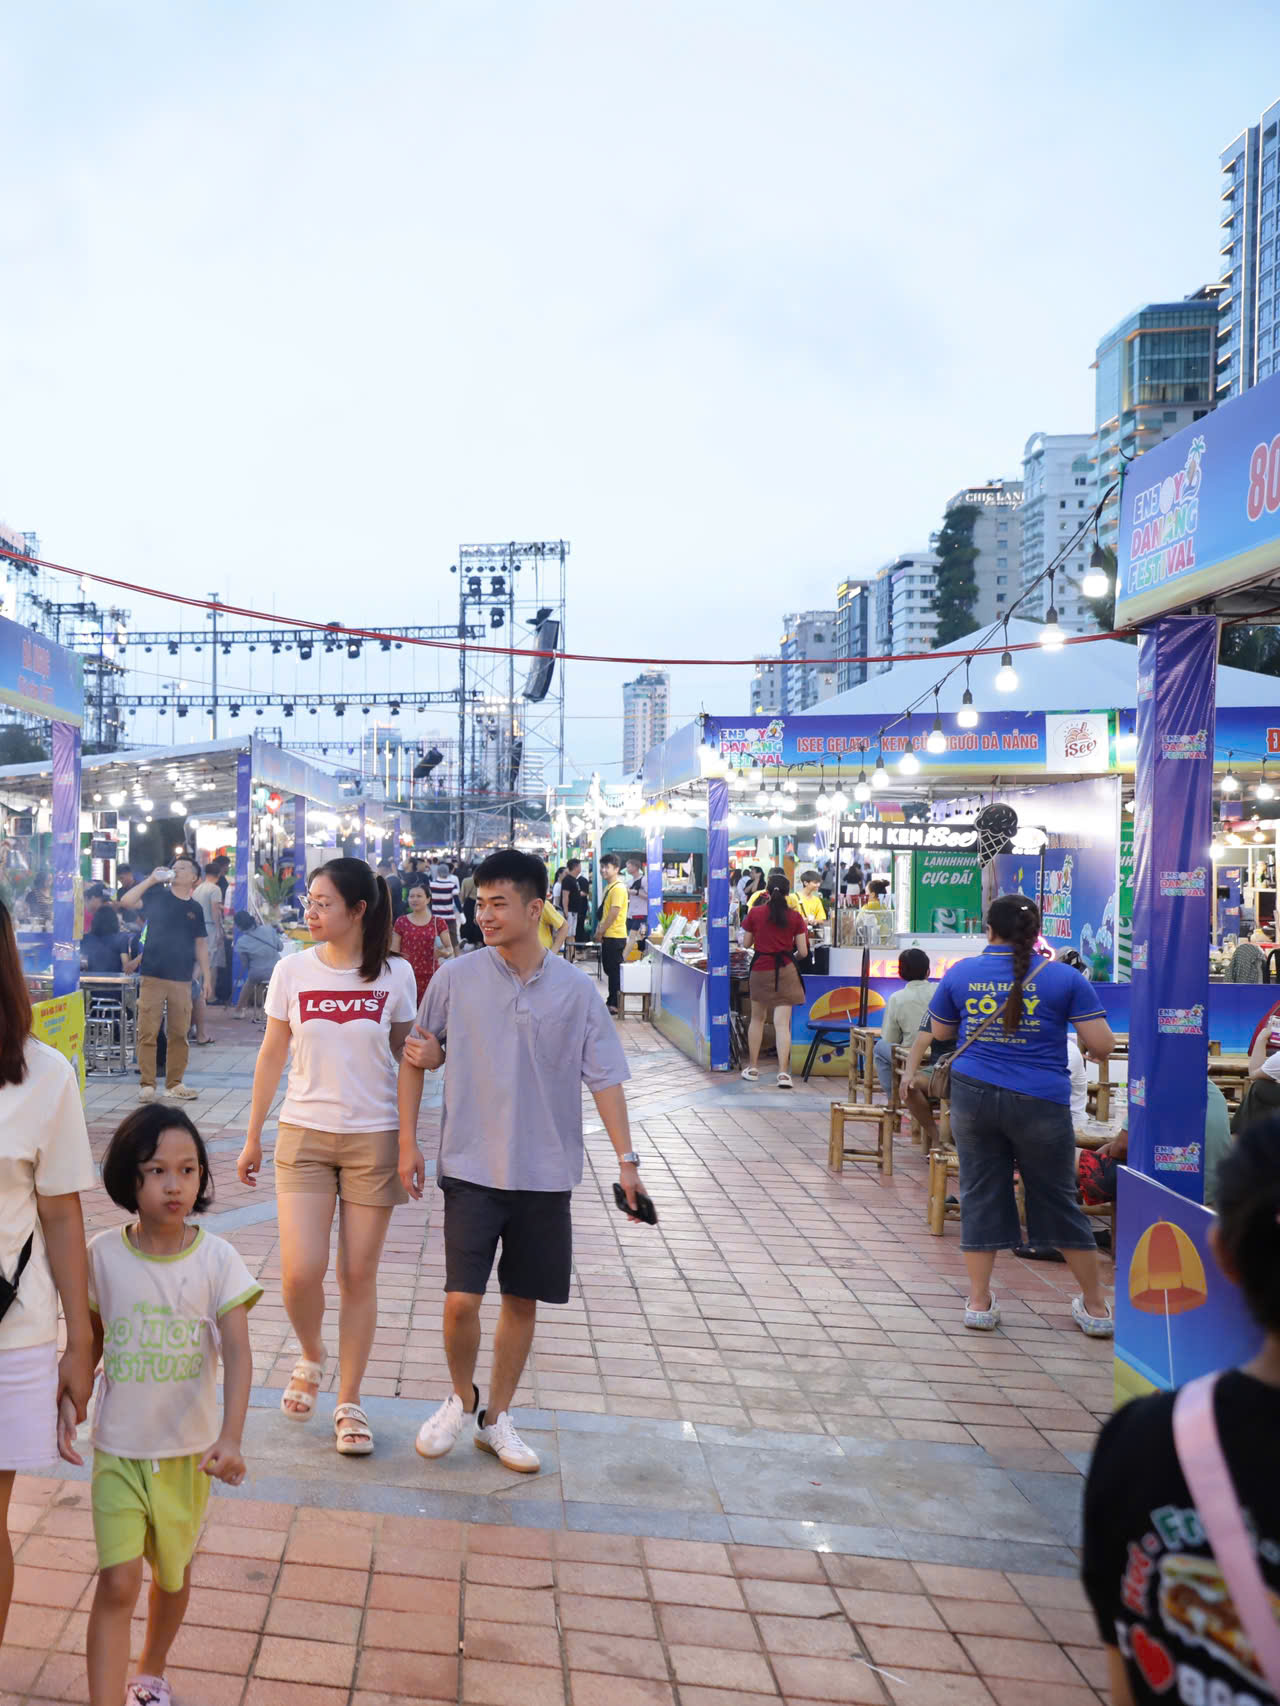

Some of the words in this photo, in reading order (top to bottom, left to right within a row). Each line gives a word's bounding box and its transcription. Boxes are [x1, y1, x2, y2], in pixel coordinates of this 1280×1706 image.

[1130, 498, 1198, 561] DANANG
[1127, 536, 1196, 594] FESTIVAL
[720, 741, 783, 753] DANANG
[797, 737, 823, 752] ISEE
[827, 737, 871, 752] GELATO
[881, 736, 908, 752] KEM
[912, 730, 930, 751] CỦ
[982, 731, 999, 750] ĐÀ
[1003, 729, 1039, 749] NẴNG
[1064, 739, 1097, 758] iSee
[720, 753, 784, 768] ESTVAL
[886, 827, 924, 846] KEM
[922, 871, 951, 887] CỰC
[950, 869, 974, 885] ĐÃ!
[1035, 870, 1063, 893] EJOY
[869, 960, 900, 978] KE
[968, 981, 995, 992] NHÀ
[965, 992, 997, 1015] CỔ
[140, 1318, 207, 1348] NOT
